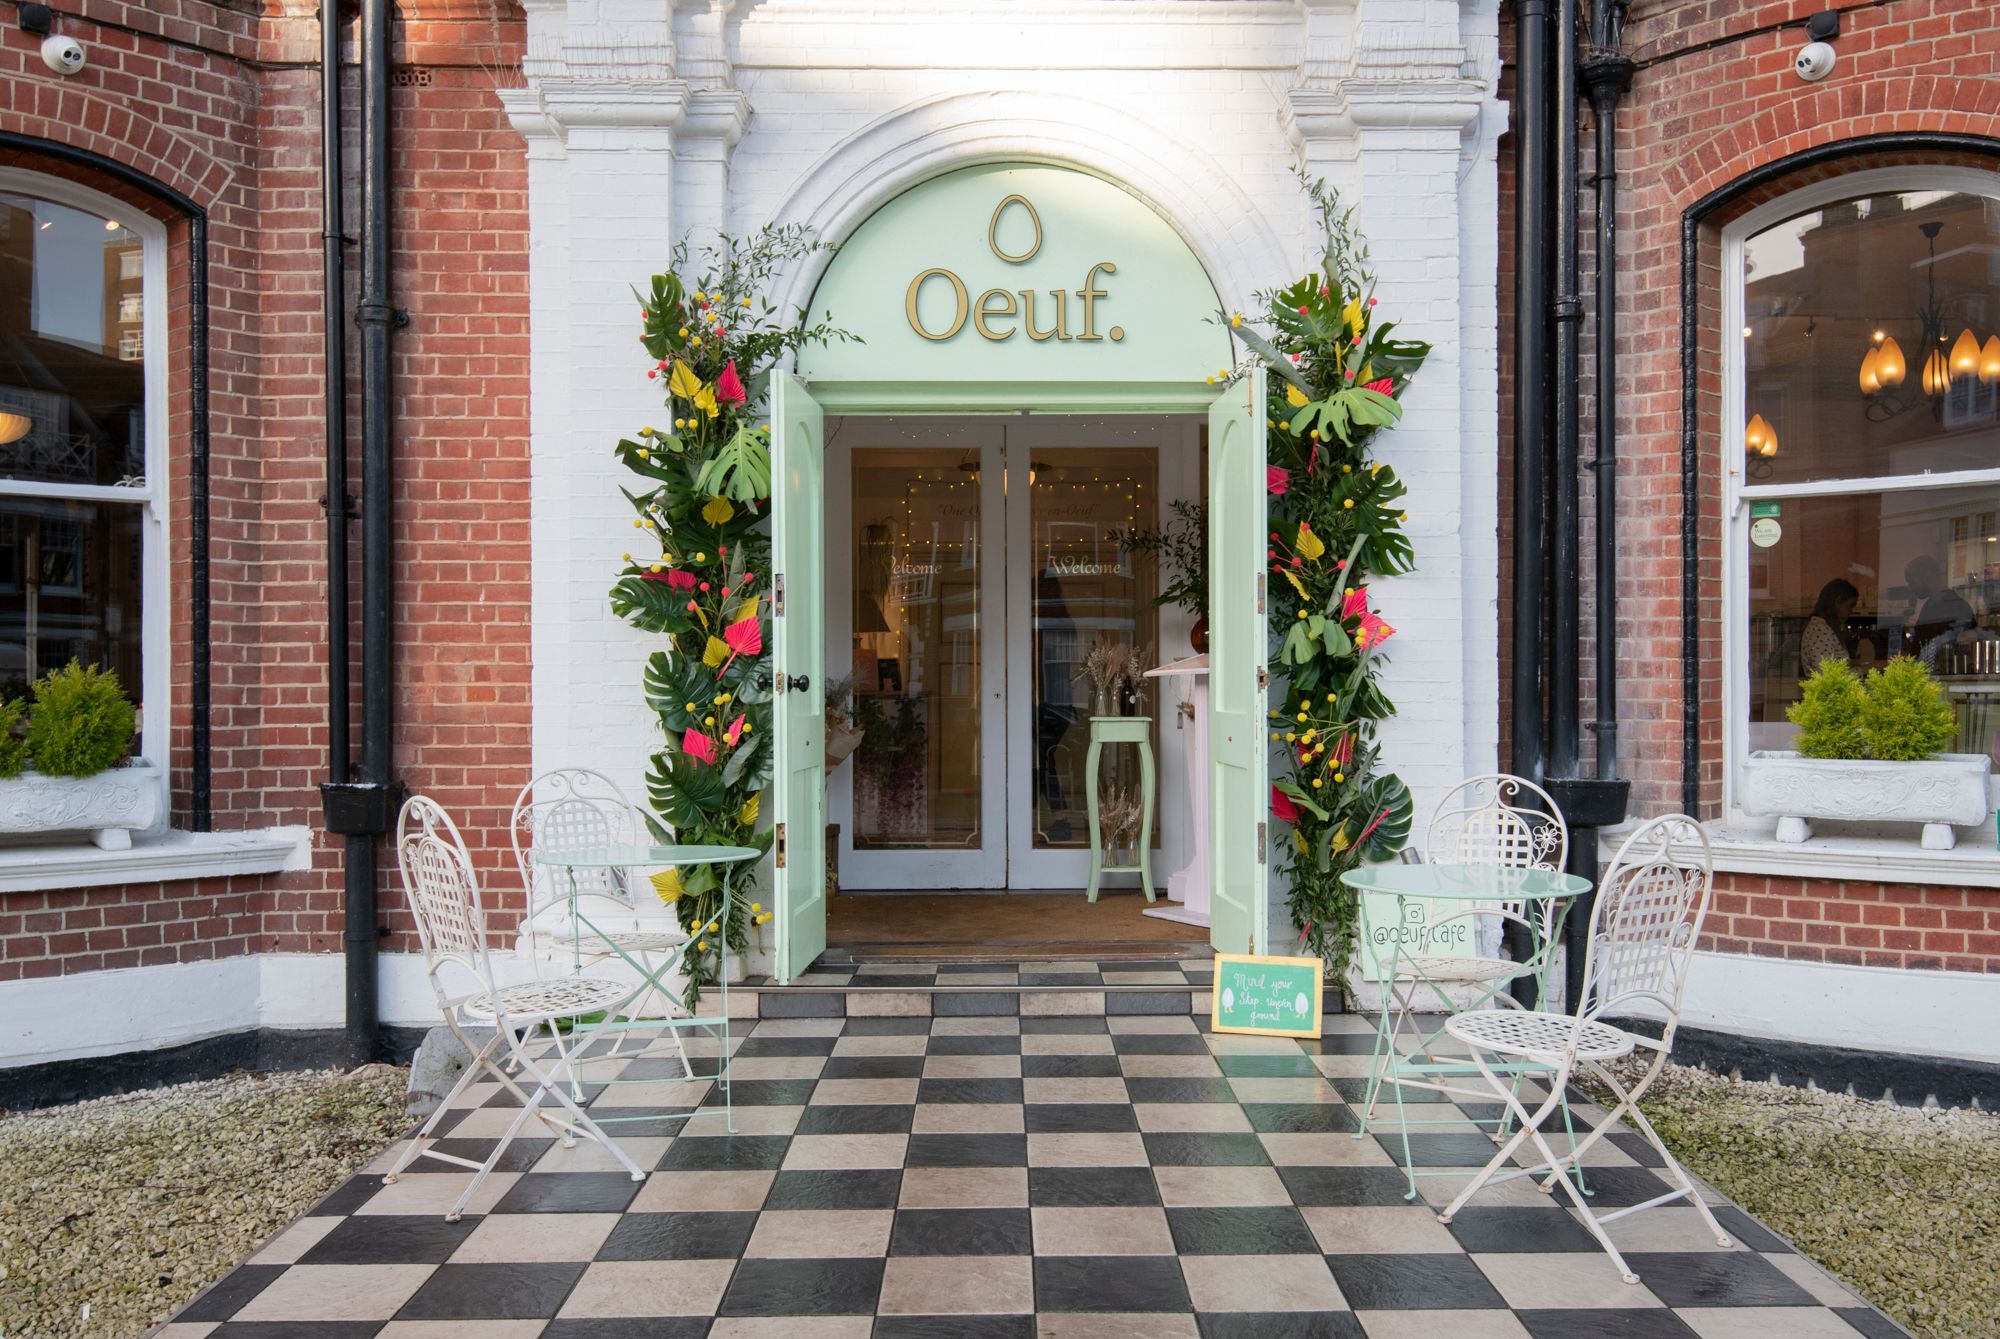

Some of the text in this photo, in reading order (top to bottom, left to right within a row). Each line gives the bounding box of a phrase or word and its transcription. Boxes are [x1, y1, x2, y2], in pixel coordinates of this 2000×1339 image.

[905, 262, 1125, 342] Oeuf.
[891, 554, 943, 575] elcome
[1049, 555, 1121, 575] Welcome
[1233, 973, 1293, 997] Mind your
[1250, 1009, 1281, 1026] ground
